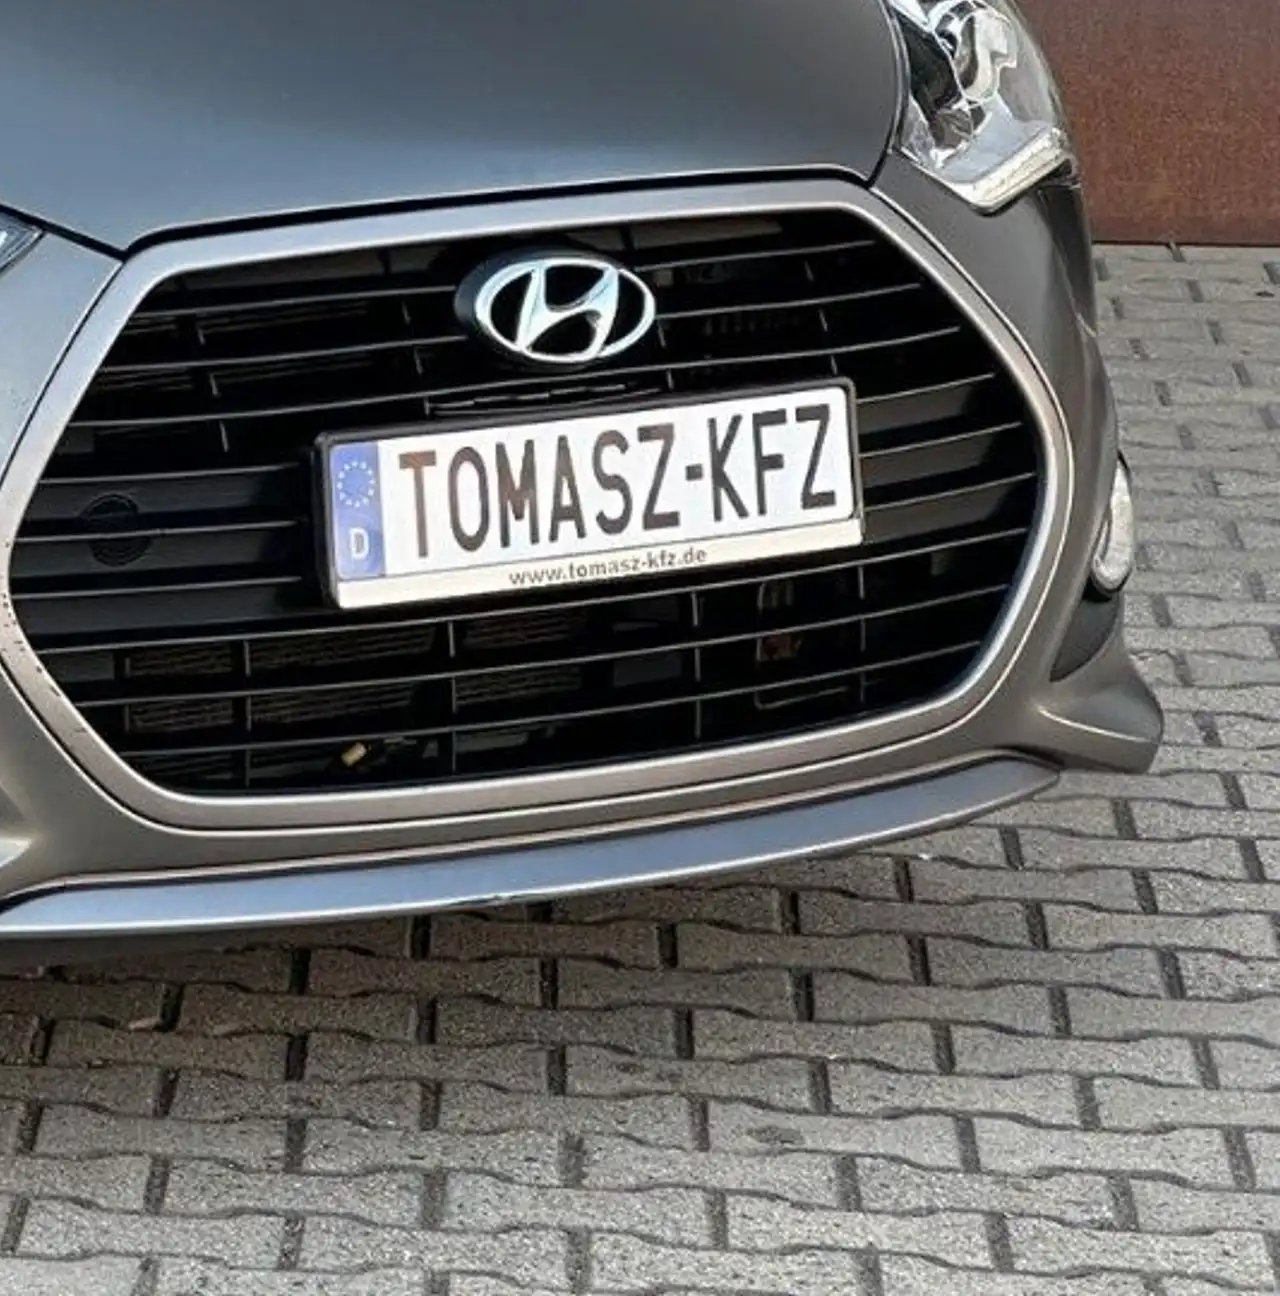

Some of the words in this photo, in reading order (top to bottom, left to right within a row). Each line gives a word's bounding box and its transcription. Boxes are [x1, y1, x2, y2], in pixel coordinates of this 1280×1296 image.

[398, 402, 838, 559] TOMASZ-KFZ
[349, 527, 370, 561] D
[508, 546, 708, 587] www.tomasz-kfz.de
